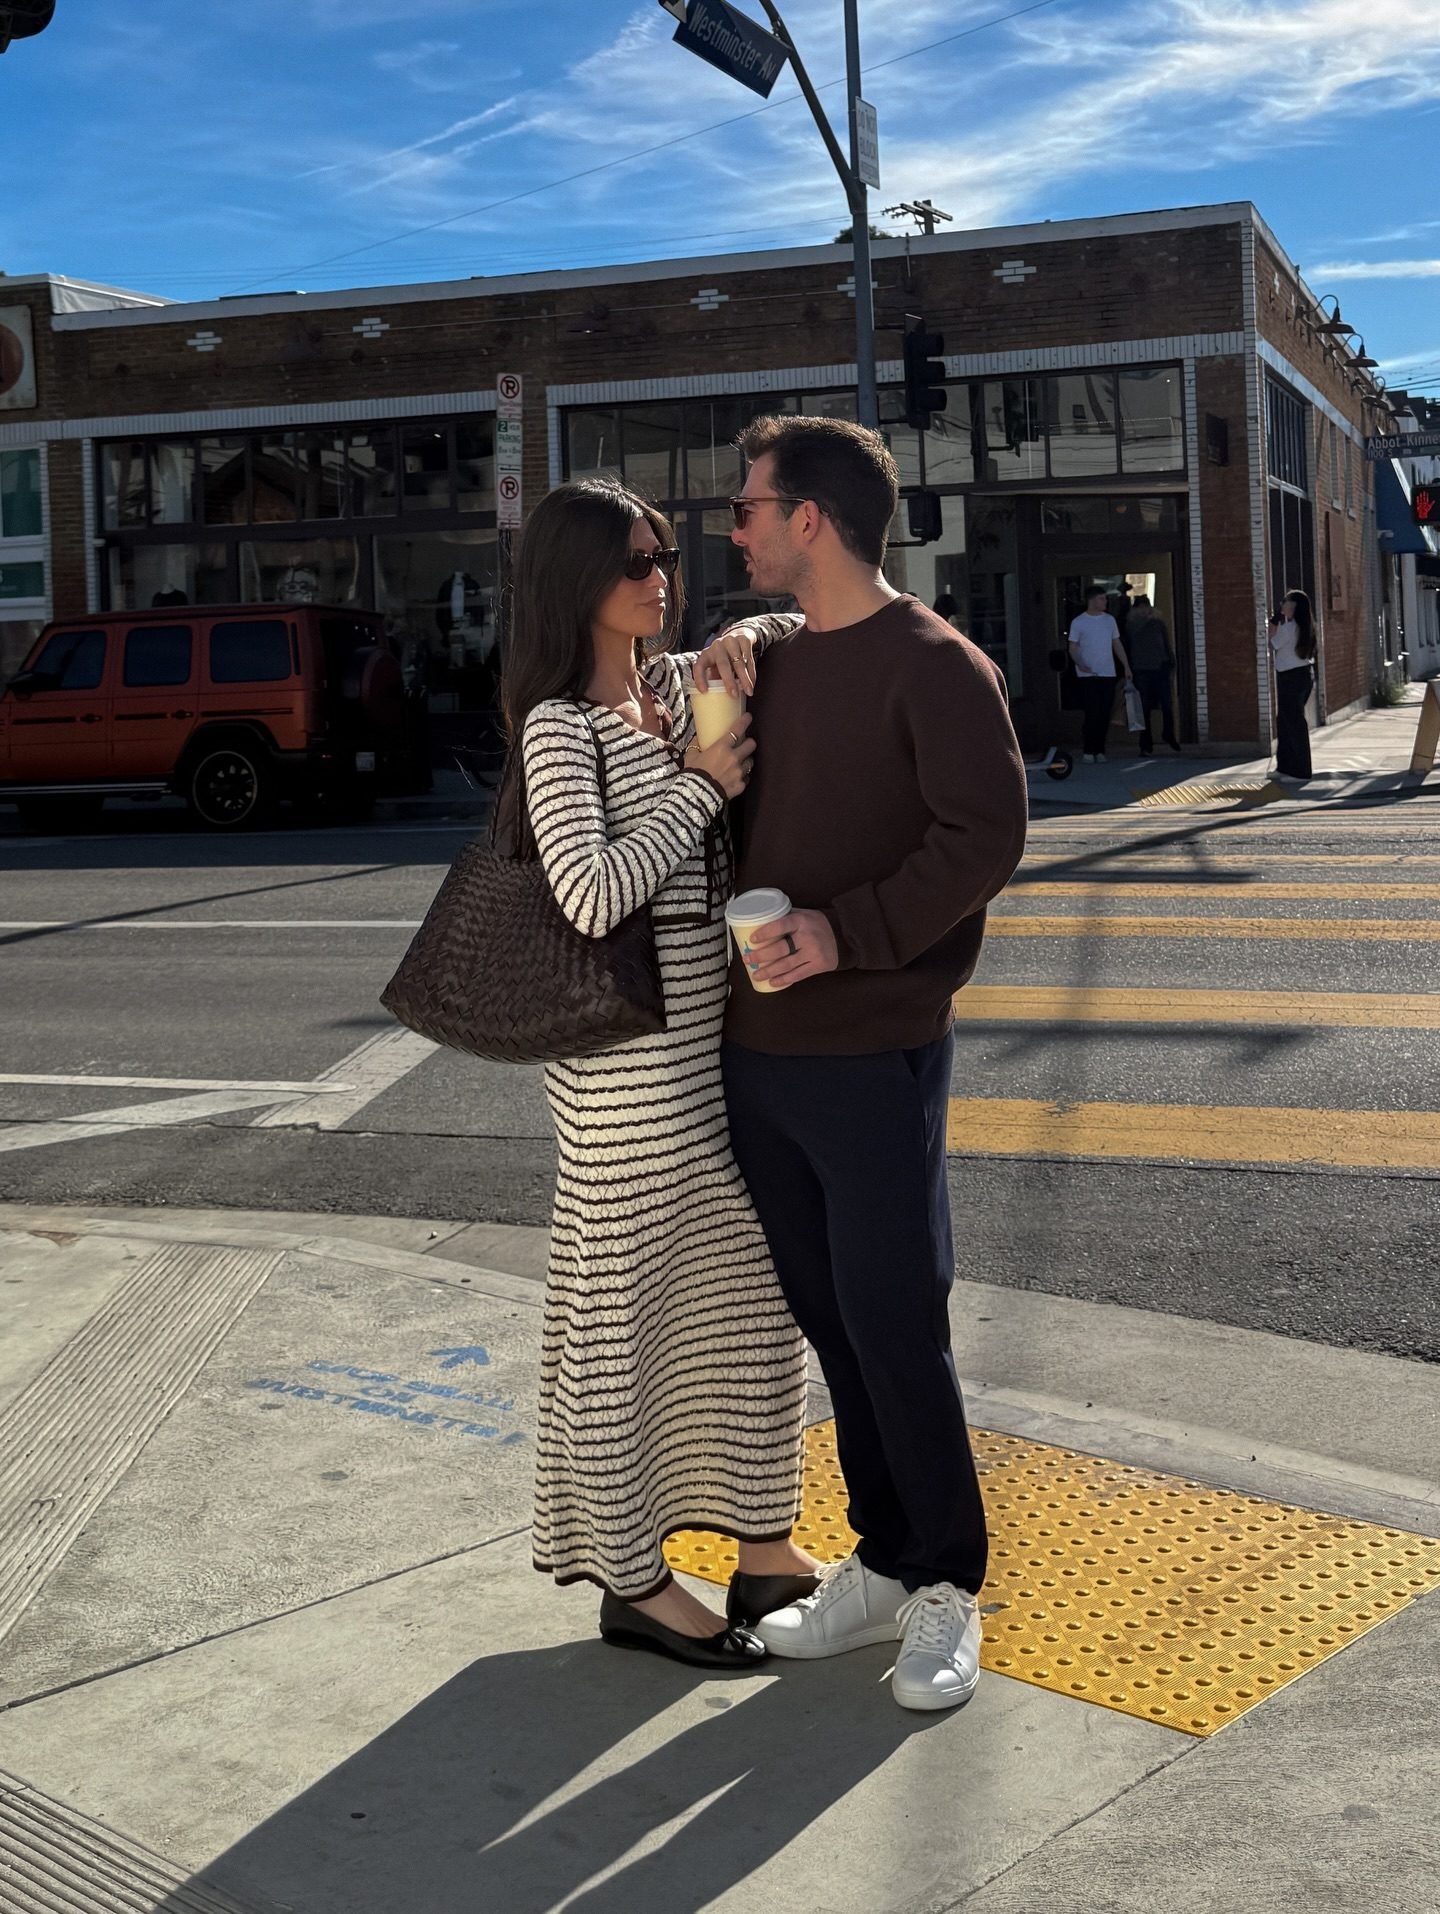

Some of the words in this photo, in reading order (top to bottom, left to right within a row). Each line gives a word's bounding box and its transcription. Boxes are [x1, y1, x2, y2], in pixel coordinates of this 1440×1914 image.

[688, 4, 761, 71] Westminster
[757, 54, 777, 81] Av
[1368, 437, 1400, 449] Abbot
[1407, 435, 1440, 447] Kinne
[1387, 448, 1393, 457] S
